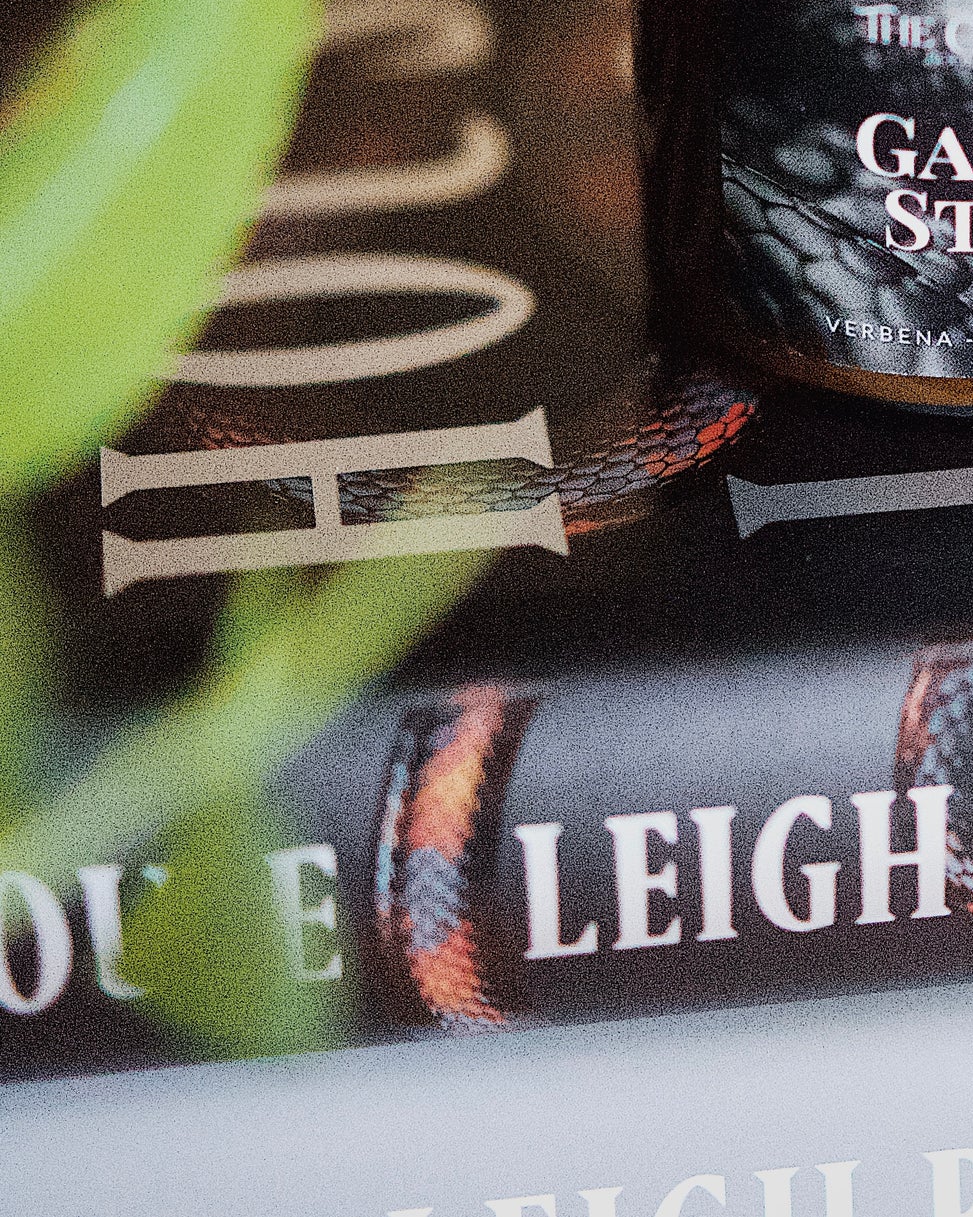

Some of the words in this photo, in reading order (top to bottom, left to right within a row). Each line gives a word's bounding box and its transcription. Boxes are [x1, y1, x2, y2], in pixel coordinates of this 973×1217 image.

[853, 3, 937, 49] THE
[824, 315, 954, 348] VERBENA
[513, 784, 953, 961] LEIGH
